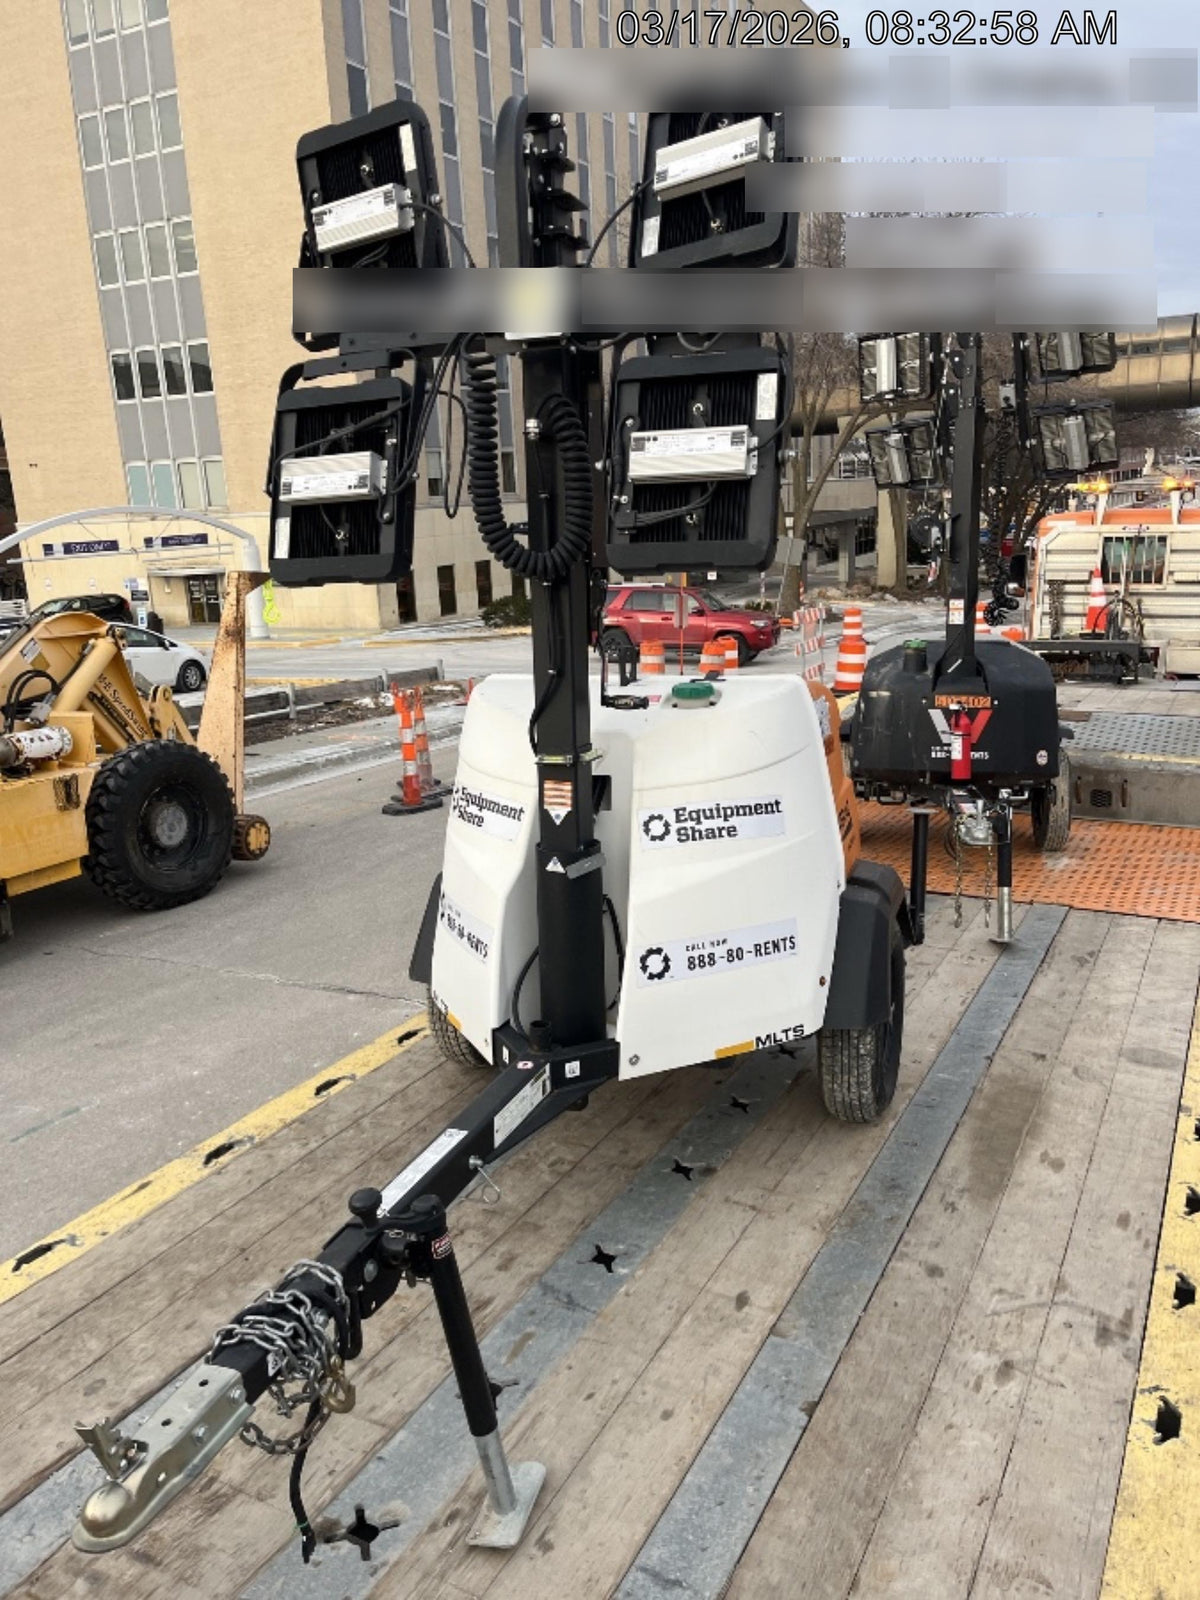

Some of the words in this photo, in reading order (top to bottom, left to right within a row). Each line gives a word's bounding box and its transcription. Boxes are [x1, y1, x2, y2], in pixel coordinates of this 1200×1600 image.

[458, 805, 485, 827] Share
[461, 787, 525, 822] Equipment
[673, 799, 783, 825] Equipment
[675, 825, 738, 843] Share
[685, 942, 706, 952] CALL
[687, 935, 796, 971] 888-80-RENTS
[755, 1024, 805, 1047] MLTS
